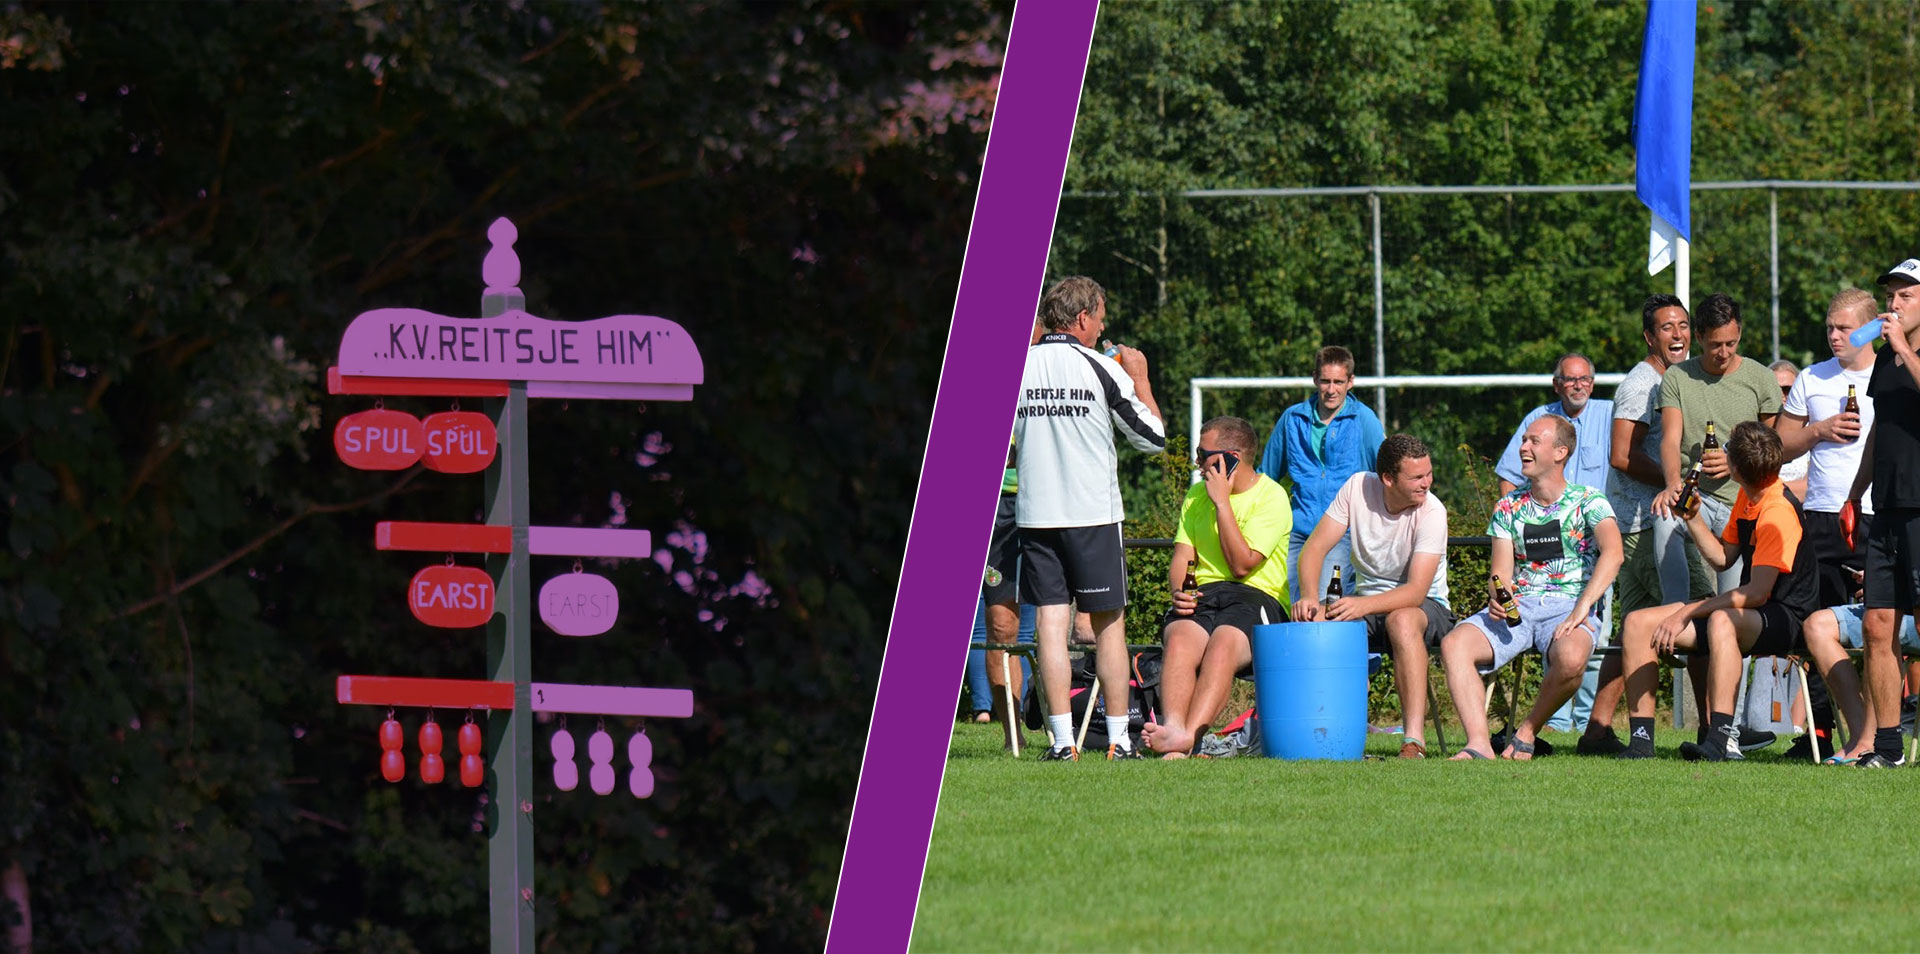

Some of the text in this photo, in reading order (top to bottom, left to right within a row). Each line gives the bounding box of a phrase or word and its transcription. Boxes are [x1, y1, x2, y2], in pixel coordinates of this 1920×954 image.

[1026, 388, 1096, 402] REITSJE HIM
[345, 426, 415, 454] SPUL
[428, 427, 489, 456] SPUL
[417, 580, 489, 611] EARST
[549, 592, 612, 618] EARST
